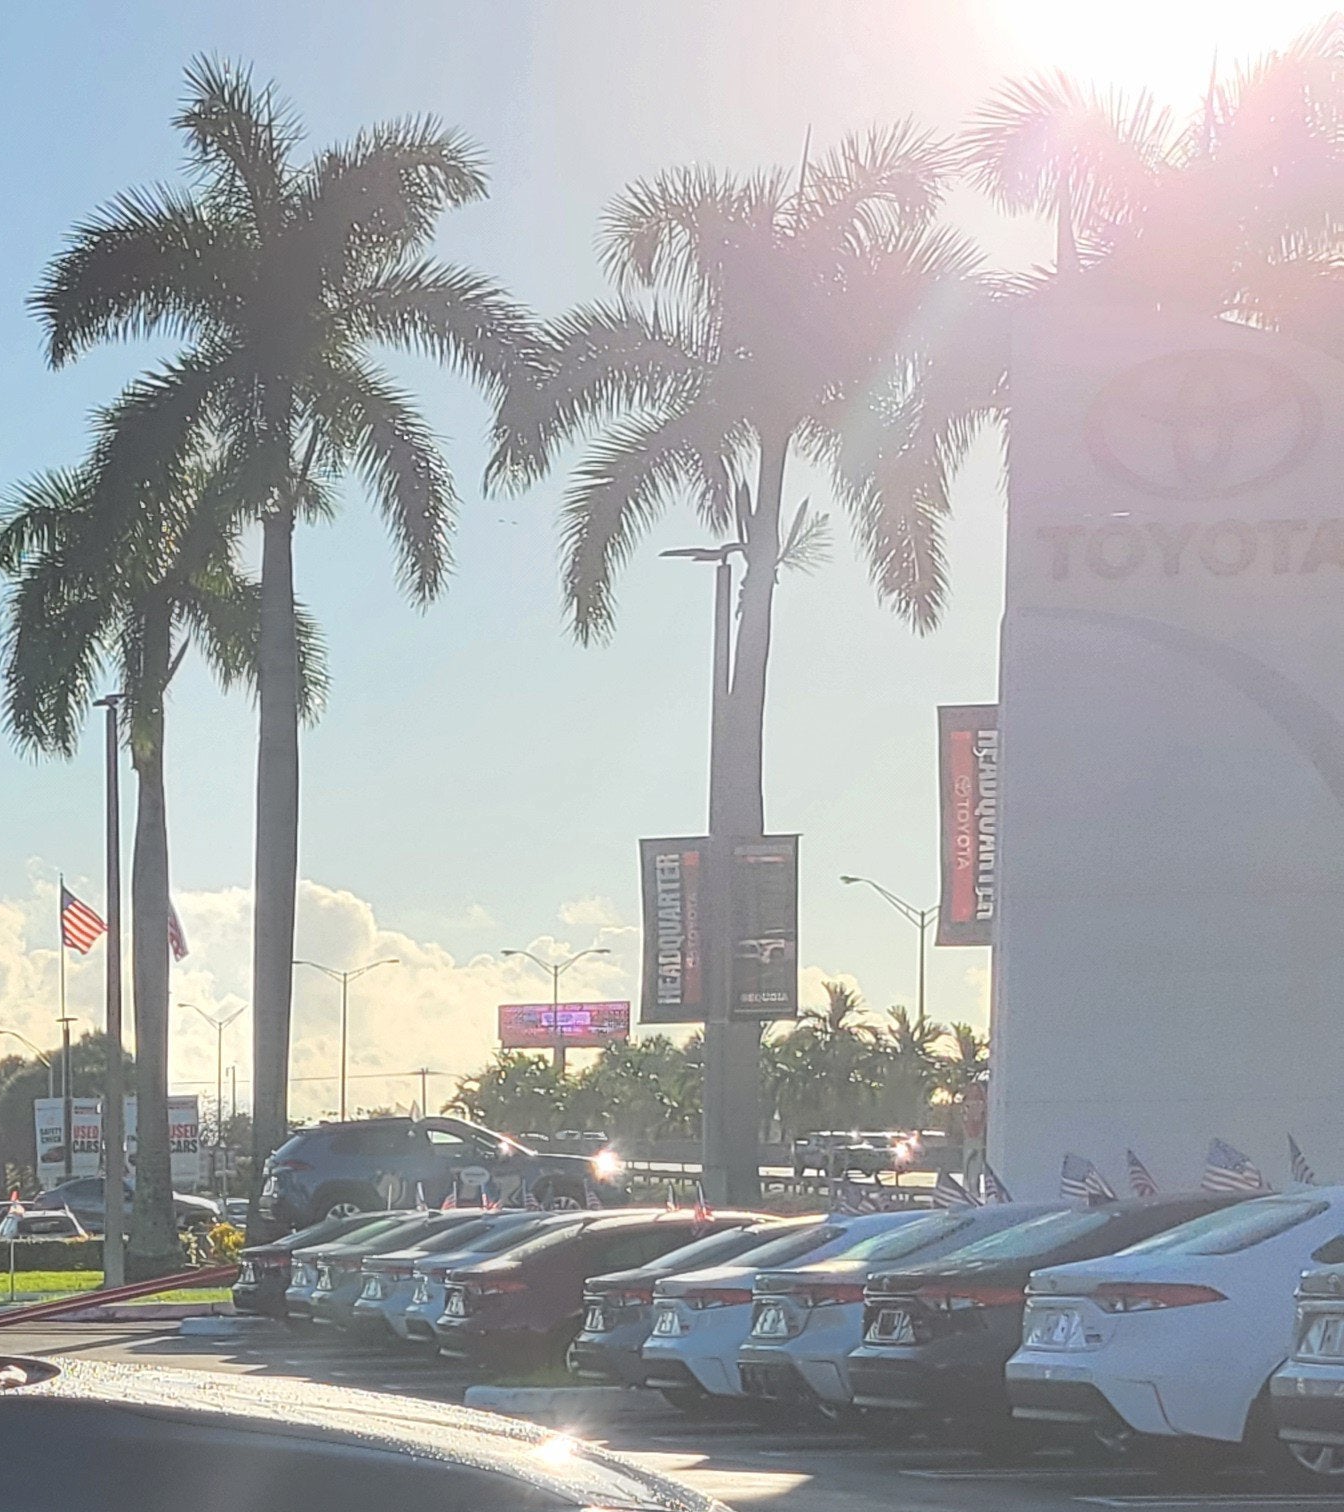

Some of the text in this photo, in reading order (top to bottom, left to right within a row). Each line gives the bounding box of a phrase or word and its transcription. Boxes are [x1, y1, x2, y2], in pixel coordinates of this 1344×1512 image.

[1036, 518, 1344, 581] TOYOTA
[656, 854, 685, 1005] HEADQUARTER
[73, 1125, 99, 1139] USED
[73, 1140, 99, 1154] CARS
